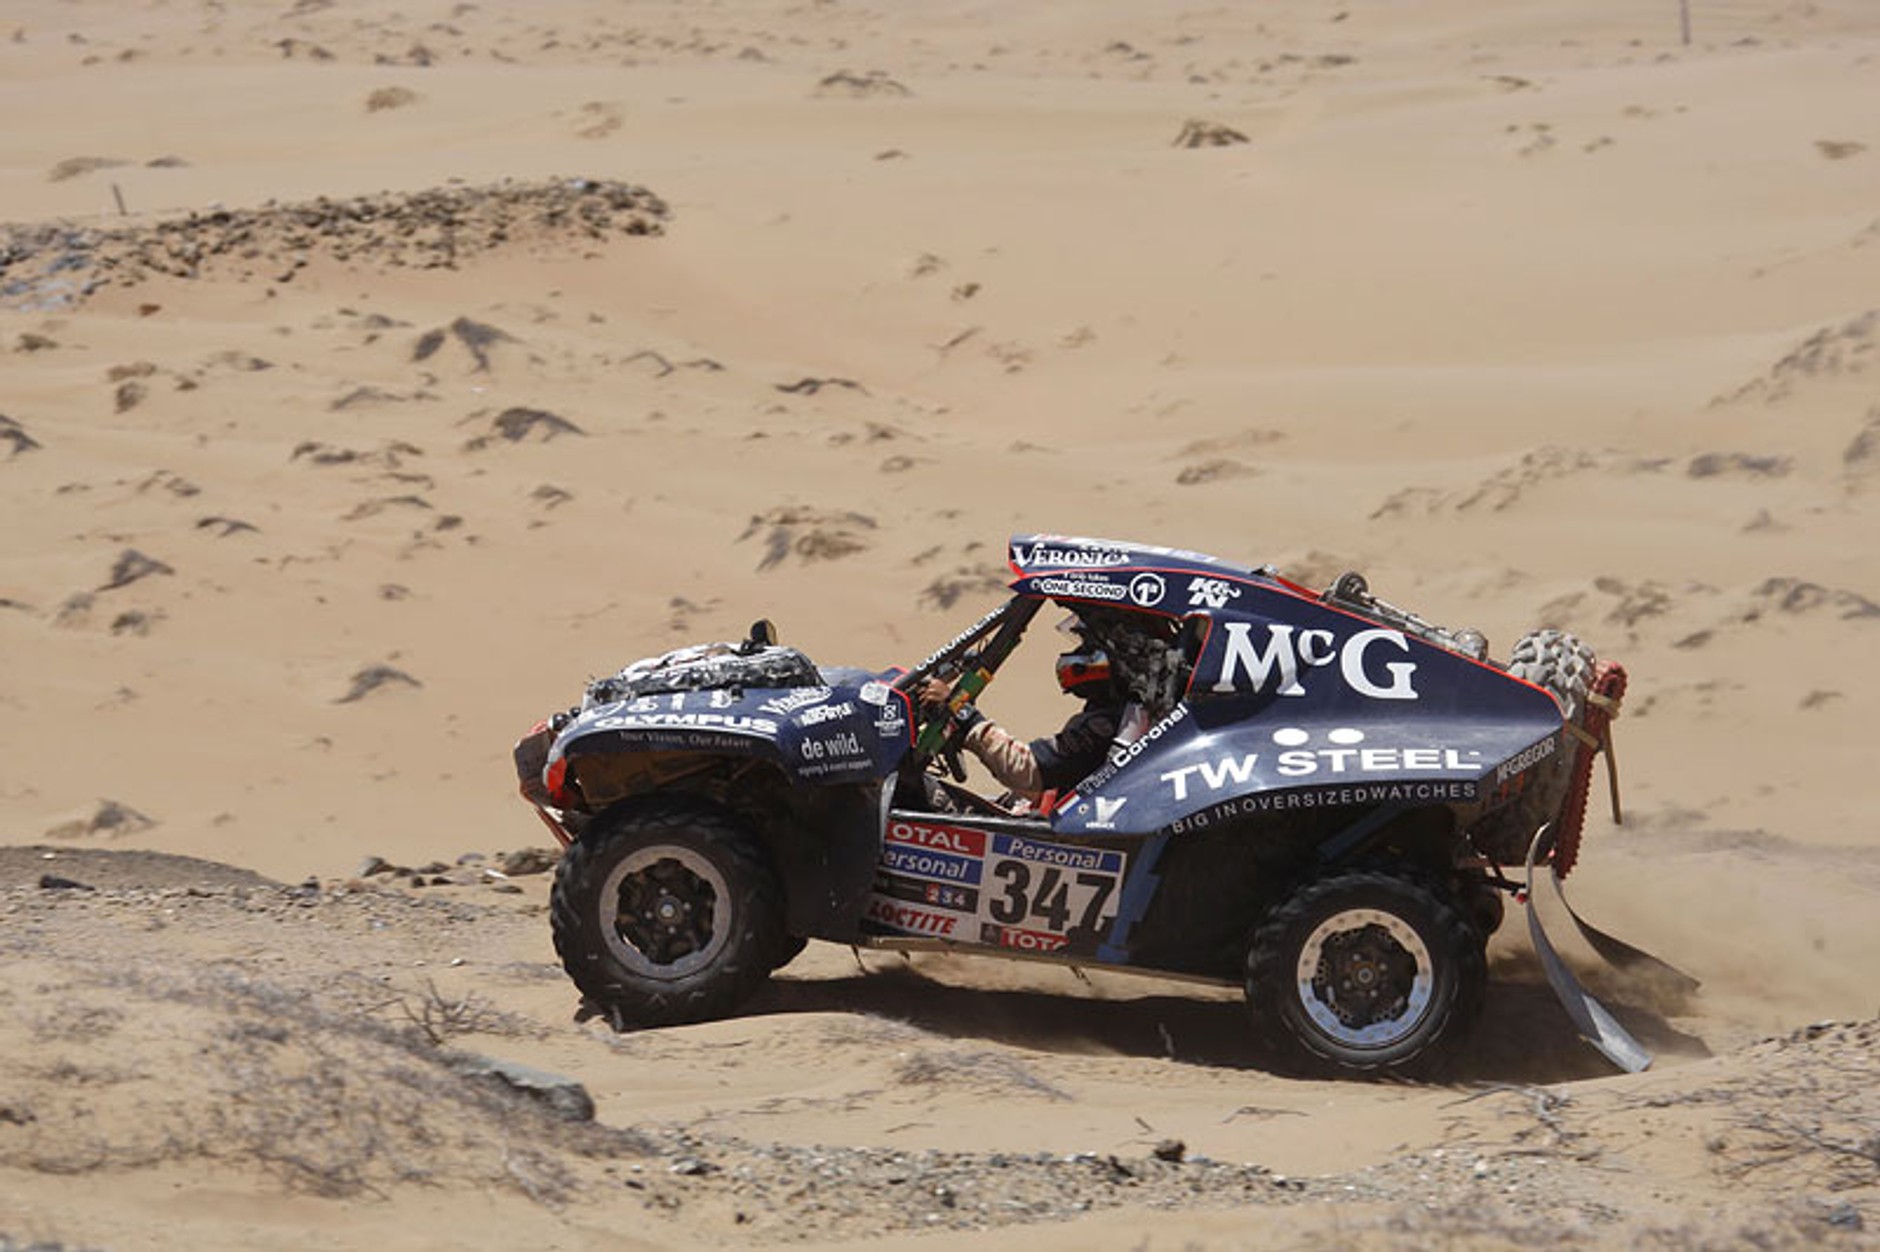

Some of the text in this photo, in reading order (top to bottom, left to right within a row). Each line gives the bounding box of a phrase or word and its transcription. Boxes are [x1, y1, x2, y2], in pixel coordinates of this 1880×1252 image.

[1043, 581, 1125, 598] ONE SECOND
[594, 713, 778, 734] OLYMPUS
[1112, 702, 1189, 767] Coronel
[801, 737, 824, 759] de
[1161, 754, 1259, 801] TW
[1277, 749, 1482, 776] STEEL
[1172, 781, 1477, 834] BIG IN OVERSIZED WATCHES
[892, 825, 970, 851] OTAL
[883, 853, 969, 879] ersonal
[1009, 838, 1103, 869] Personal
[989, 860, 1118, 933] 347
